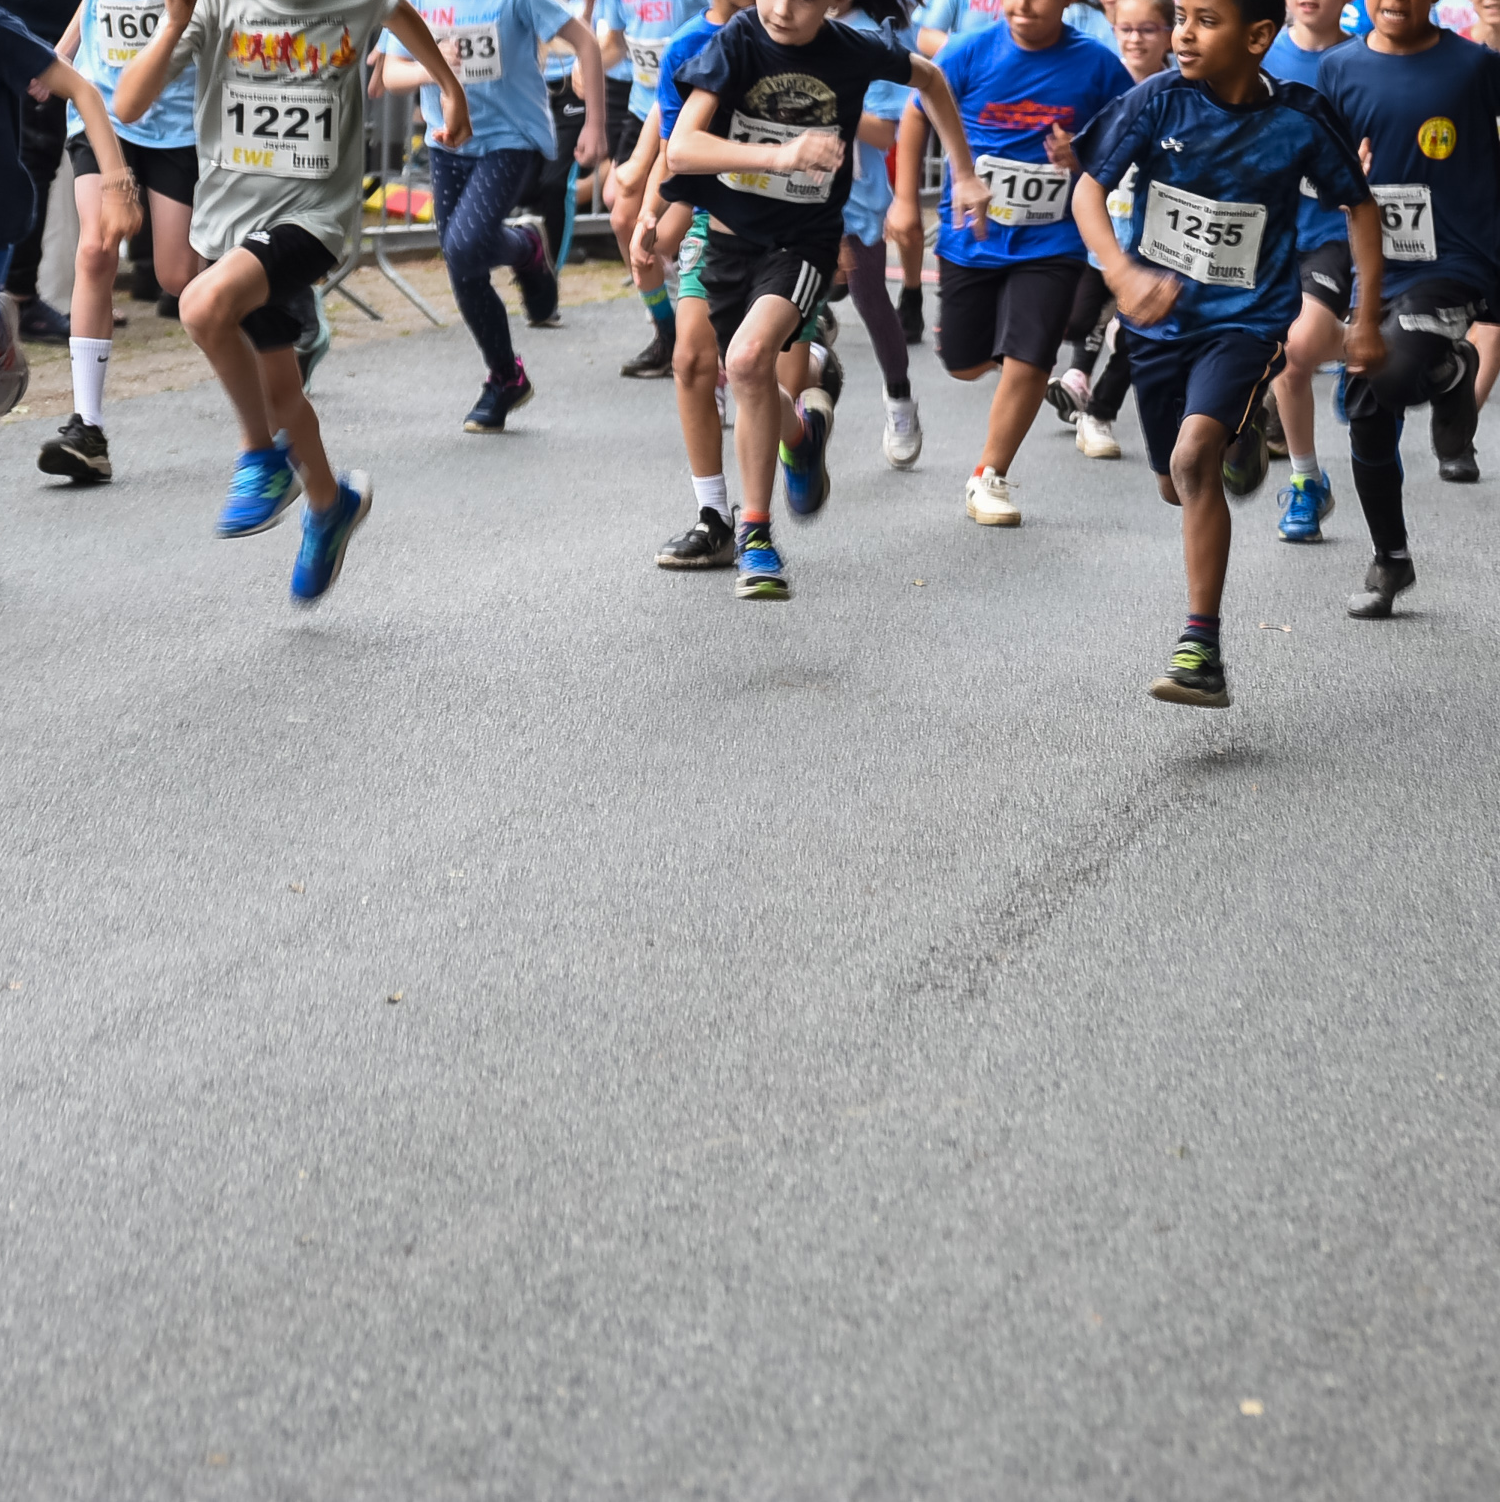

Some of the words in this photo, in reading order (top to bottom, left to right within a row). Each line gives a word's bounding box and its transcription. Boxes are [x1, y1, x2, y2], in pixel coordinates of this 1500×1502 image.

[227, 102, 332, 141] 1221
[232, 147, 275, 168] EWE
[292, 153, 330, 170] bruns
[978, 170, 1067, 202] 1107
[1165, 208, 1245, 247] 1255
[1207, 261, 1246, 279] bruns
